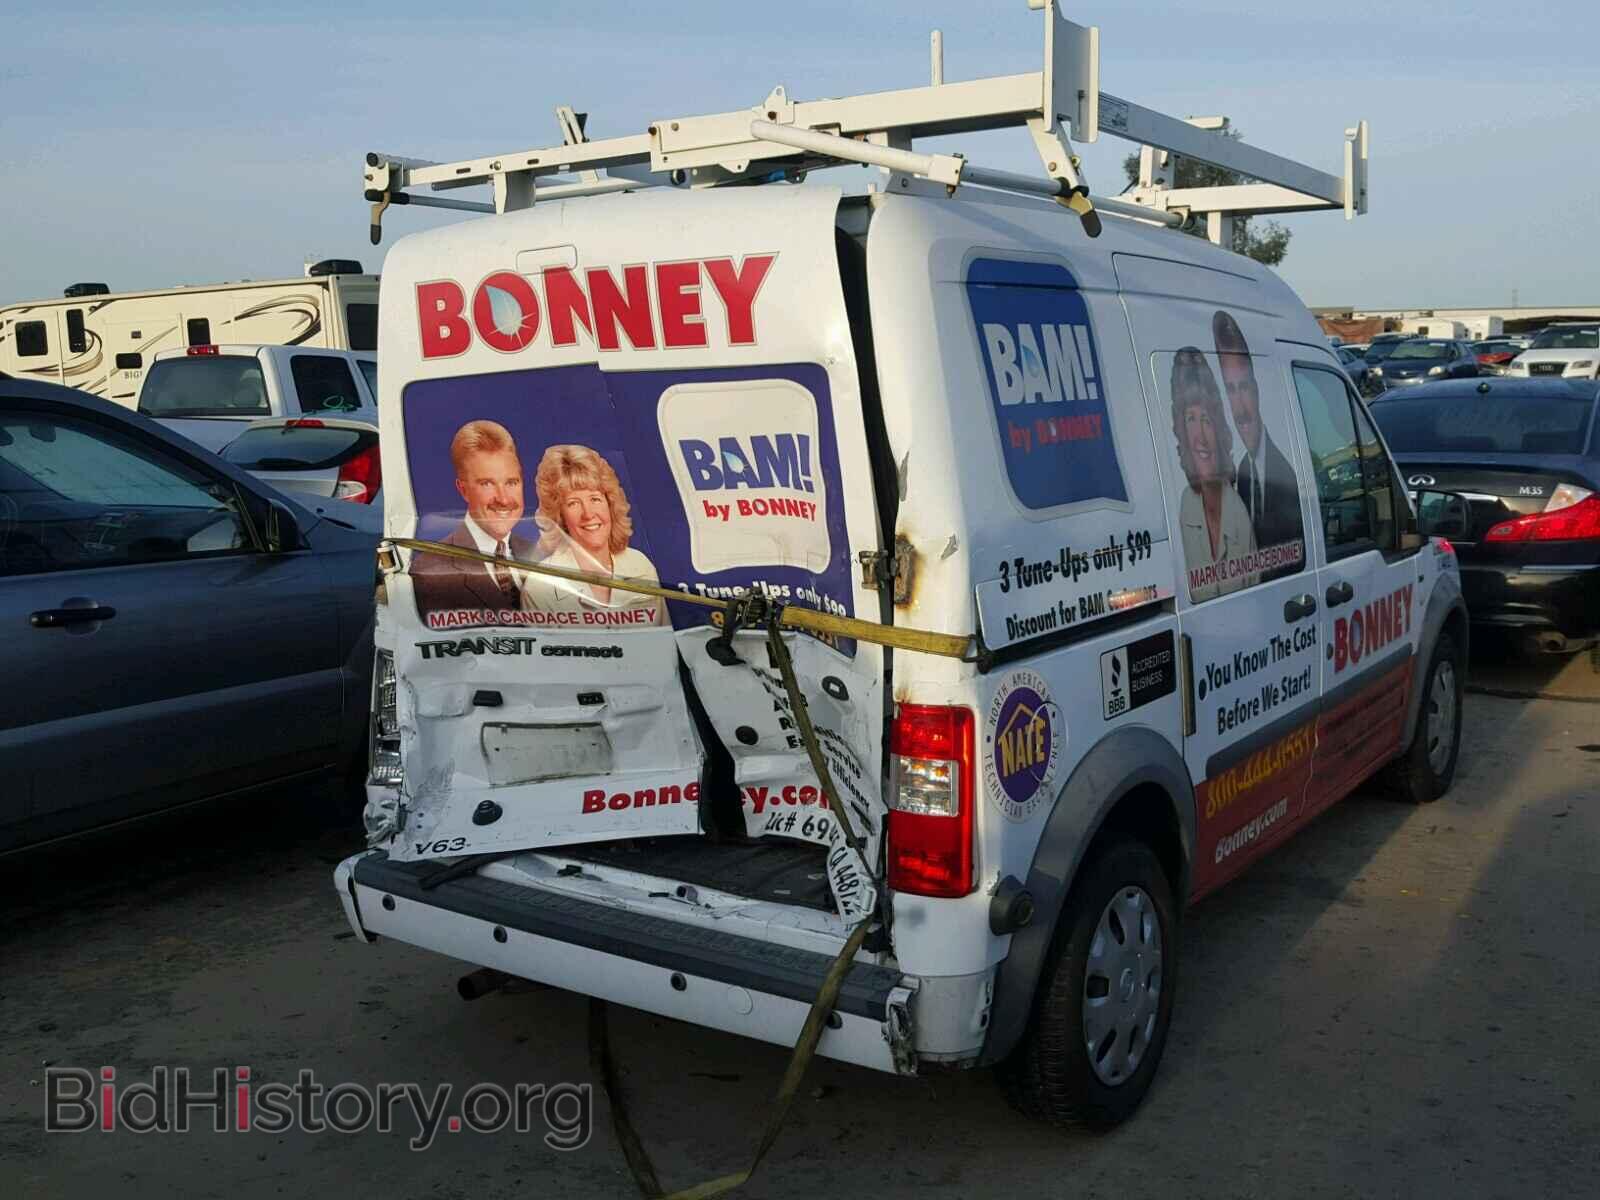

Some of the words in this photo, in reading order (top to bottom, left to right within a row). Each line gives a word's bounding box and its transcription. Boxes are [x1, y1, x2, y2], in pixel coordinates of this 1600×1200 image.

[414, 251, 780, 361] BONNEY
[982, 323, 1098, 406] BAM!
[1035, 414, 1103, 446] BONNEY
[679, 433, 815, 493] BAM!
[703, 500, 730, 521] by
[736, 498, 816, 522] BONNEY
[1519, 486, 1543, 496] M35
[999, 561, 1010, 593] 3
[1014, 547, 1089, 590] Tune-Ups
[1093, 535, 1124, 571] only
[1127, 530, 1152, 566] $99
[1190, 564, 1218, 589] MARK
[1229, 550, 1271, 578] CANDACE
[1271, 542, 1304, 567] BONNEY
[429, 611, 481, 628] MARK
[484, 612, 497, 625] &
[500, 610, 581, 626] CANDACE
[585, 608, 657, 626] BONNEY
[1006, 607, 1057, 641] Discount
[1059, 600, 1076, 625] for
[1078, 592, 1105, 620] BAM
[1334, 583, 1413, 675] BONNEY
[415, 637, 537, 660] TRANSIT
[541, 644, 624, 659] connect
[1206, 662, 1231, 692] You
[1234, 648, 1268, 681] Know
[1269, 634, 1291, 664] The
[1293, 624, 1317, 652] Cost
[989, 683, 1009, 727] NORTH
[1108, 695, 1126, 714] BBB
[1217, 697, 1259, 736] Before
[1261, 683, 1279, 712] We
[1281, 664, 1311, 702] Start!
[998, 716, 1047, 777] NATE
[764, 811, 797, 833] Lic#
[1215, 797, 1289, 864] Bonney.com
